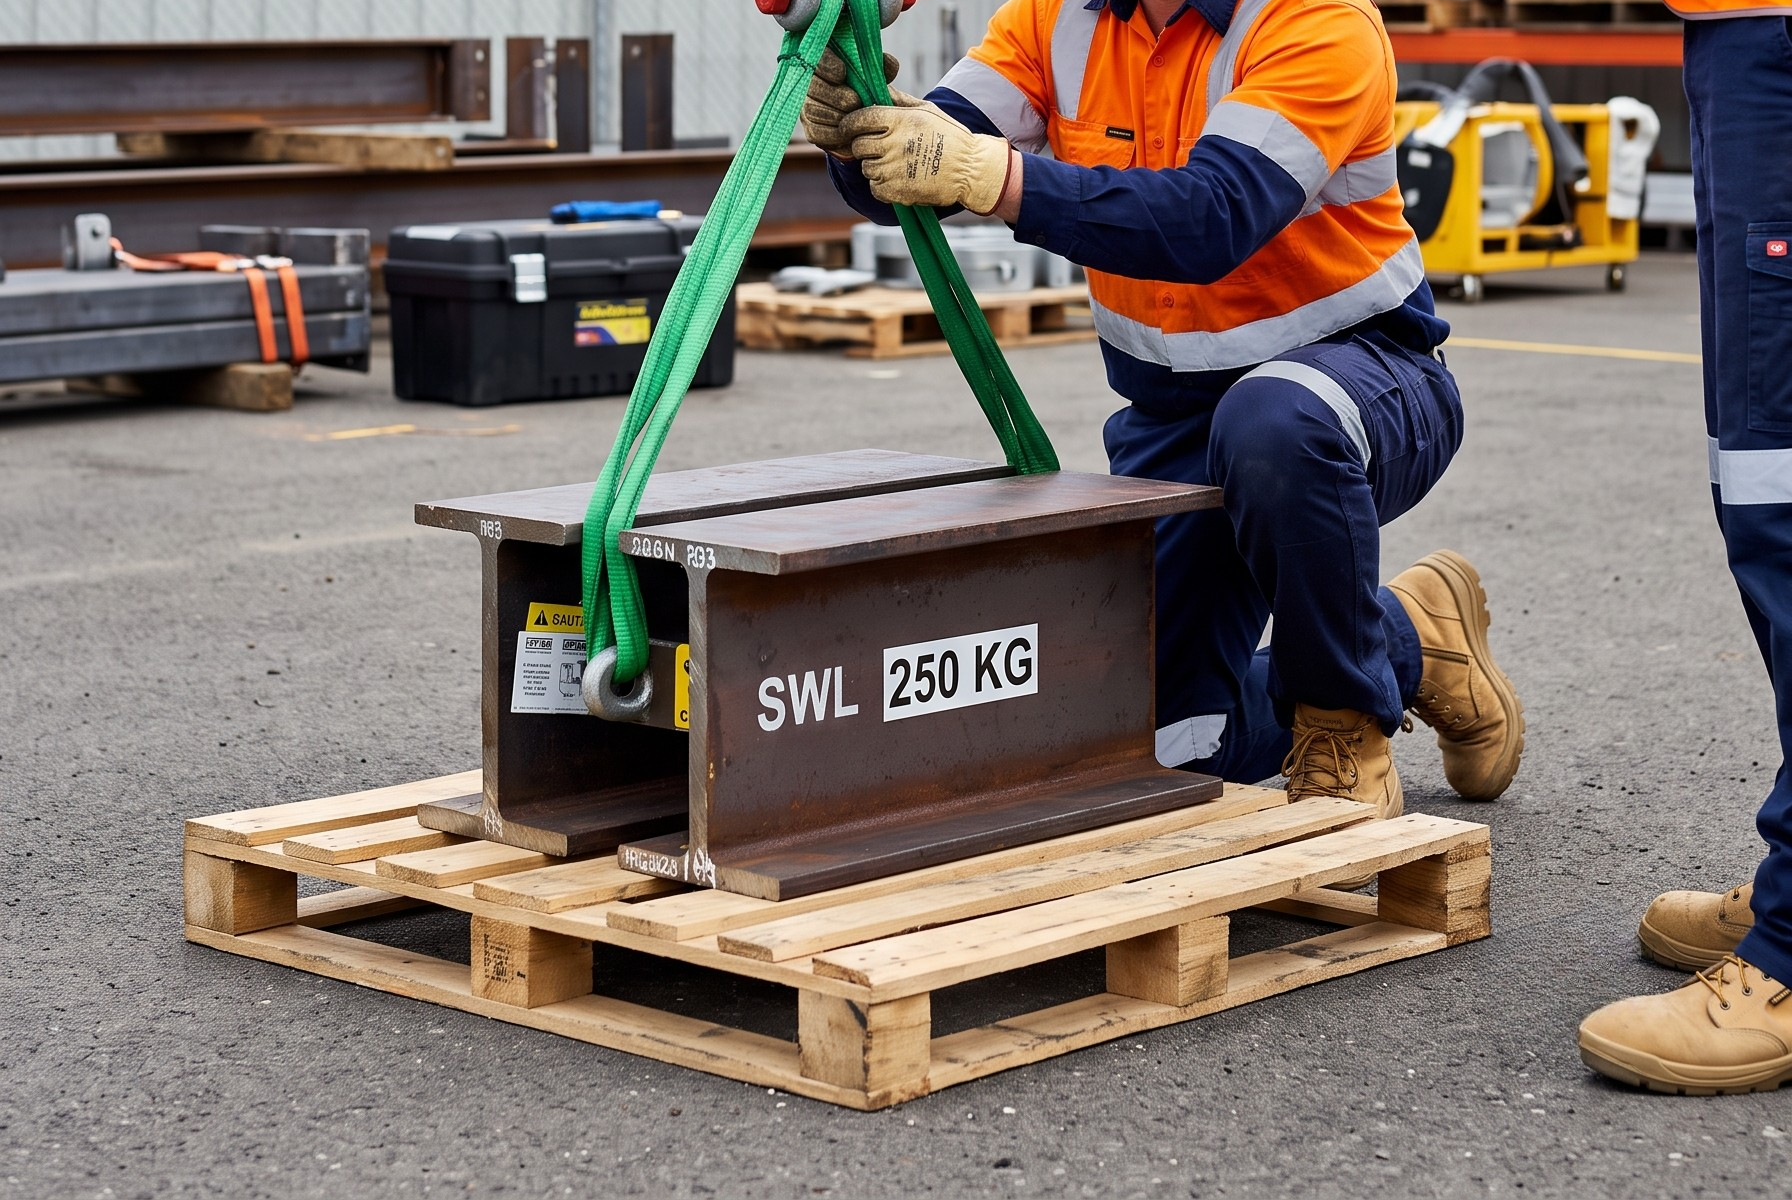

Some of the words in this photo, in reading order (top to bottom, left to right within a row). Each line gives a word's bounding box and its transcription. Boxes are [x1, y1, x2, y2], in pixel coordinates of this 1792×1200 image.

[757, 666, 859, 732] SWL
[889, 650, 959, 708] 250
[975, 637, 1033, 693] KG
